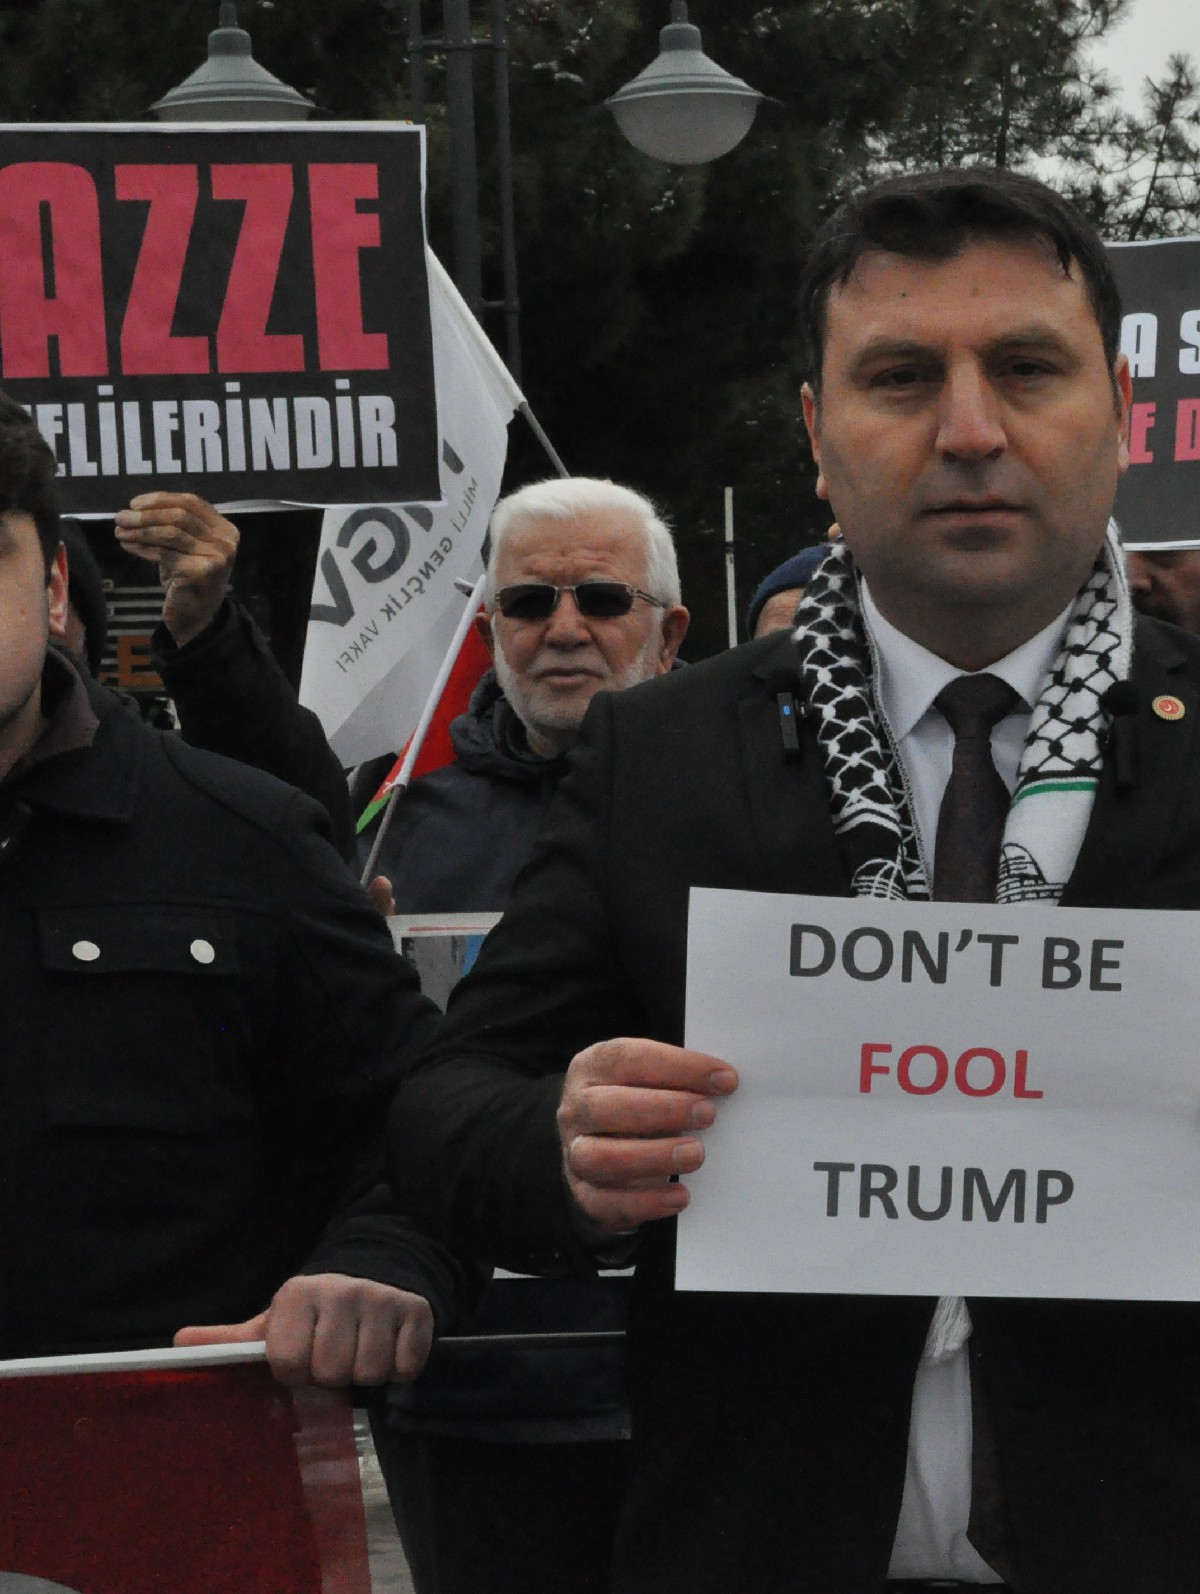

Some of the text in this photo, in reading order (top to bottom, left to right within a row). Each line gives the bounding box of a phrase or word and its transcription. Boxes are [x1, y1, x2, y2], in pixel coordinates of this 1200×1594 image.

[0, 162, 390, 378] AZZE
[20, 379, 398, 477] ELİLERİNDİR
[789, 923, 1124, 991] DON’T BE
[859, 1042, 1043, 1099] FOOL
[813, 1161, 1074, 1223] TRUMP
